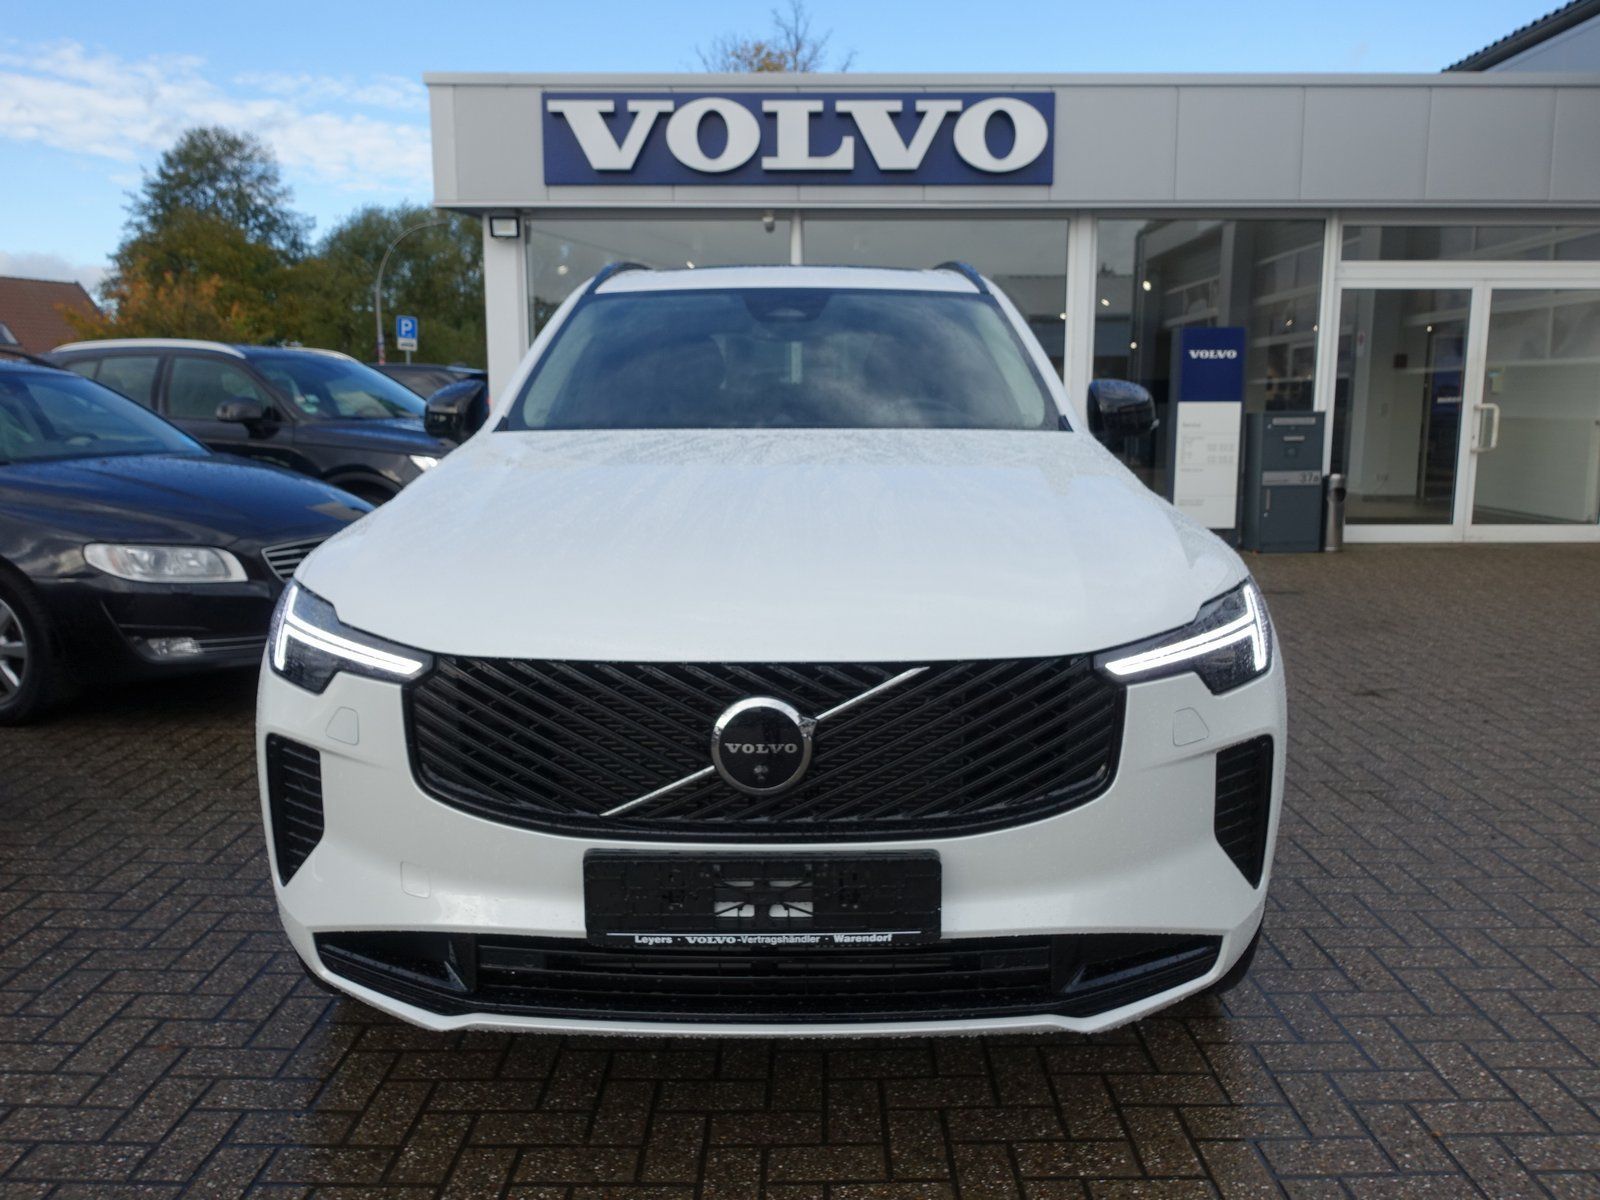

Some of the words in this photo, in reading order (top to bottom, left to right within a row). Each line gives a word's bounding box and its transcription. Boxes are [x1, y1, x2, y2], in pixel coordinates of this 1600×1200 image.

[547, 97, 1048, 173] VOLVO
[401, 319, 412, 336] P
[1188, 349, 1238, 360] VOLVO
[724, 743, 798, 754] VOLVO
[634, 935, 673, 945] Leyers
[833, 933, 893, 943] Warendorf
